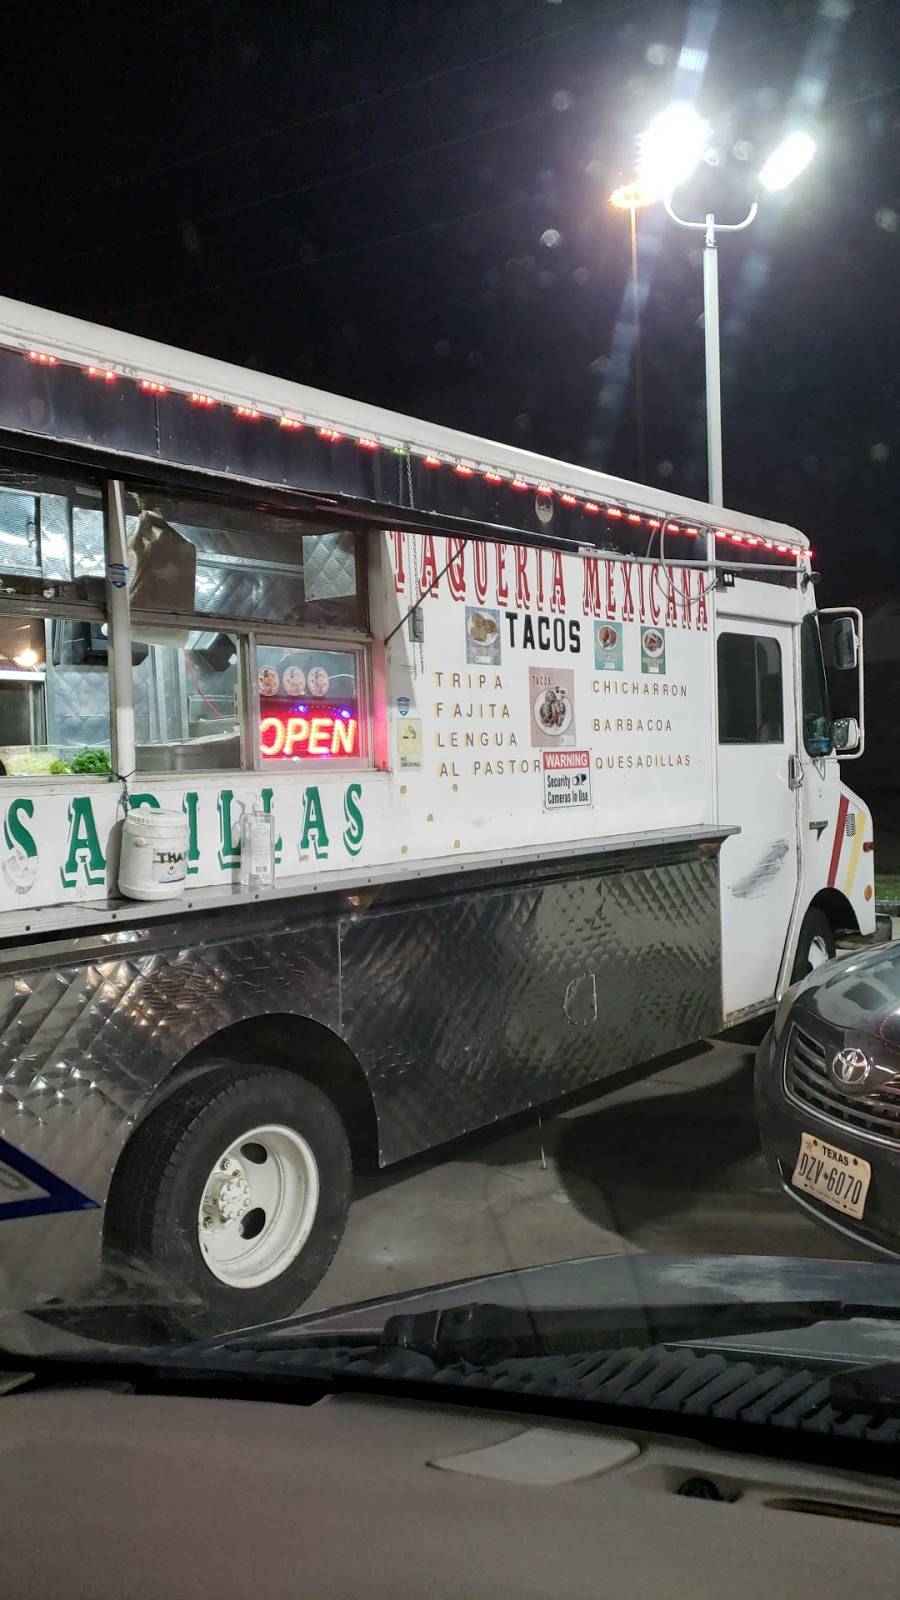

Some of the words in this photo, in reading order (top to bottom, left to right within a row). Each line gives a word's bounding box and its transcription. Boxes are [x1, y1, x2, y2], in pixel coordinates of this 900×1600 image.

[390, 530, 565, 614] TAQUERIA
[582, 555, 708, 632] MEXICANA
[505, 611, 580, 653] TACOS
[433, 672, 503, 690] TRIPA
[592, 680, 687, 697] CHICHARRON
[434, 702, 510, 718] FAJITA
[592, 718, 672, 732] BARBACOA
[259, 717, 358, 755] OPEN
[435, 732, 517, 748] LENGUA
[438, 762, 459, 777] AL
[473, 760, 541, 775] PASTOR
[545, 753, 588, 768] WARNING
[595, 755, 691, 769] QUESADILLAS
[547, 774, 570, 789] Security
[547, 791, 571, 804] Cameras
[578, 789, 588, 802] Use
[156, 851, 186, 864] THA
[822, 1145, 849, 1166] TEXAS
